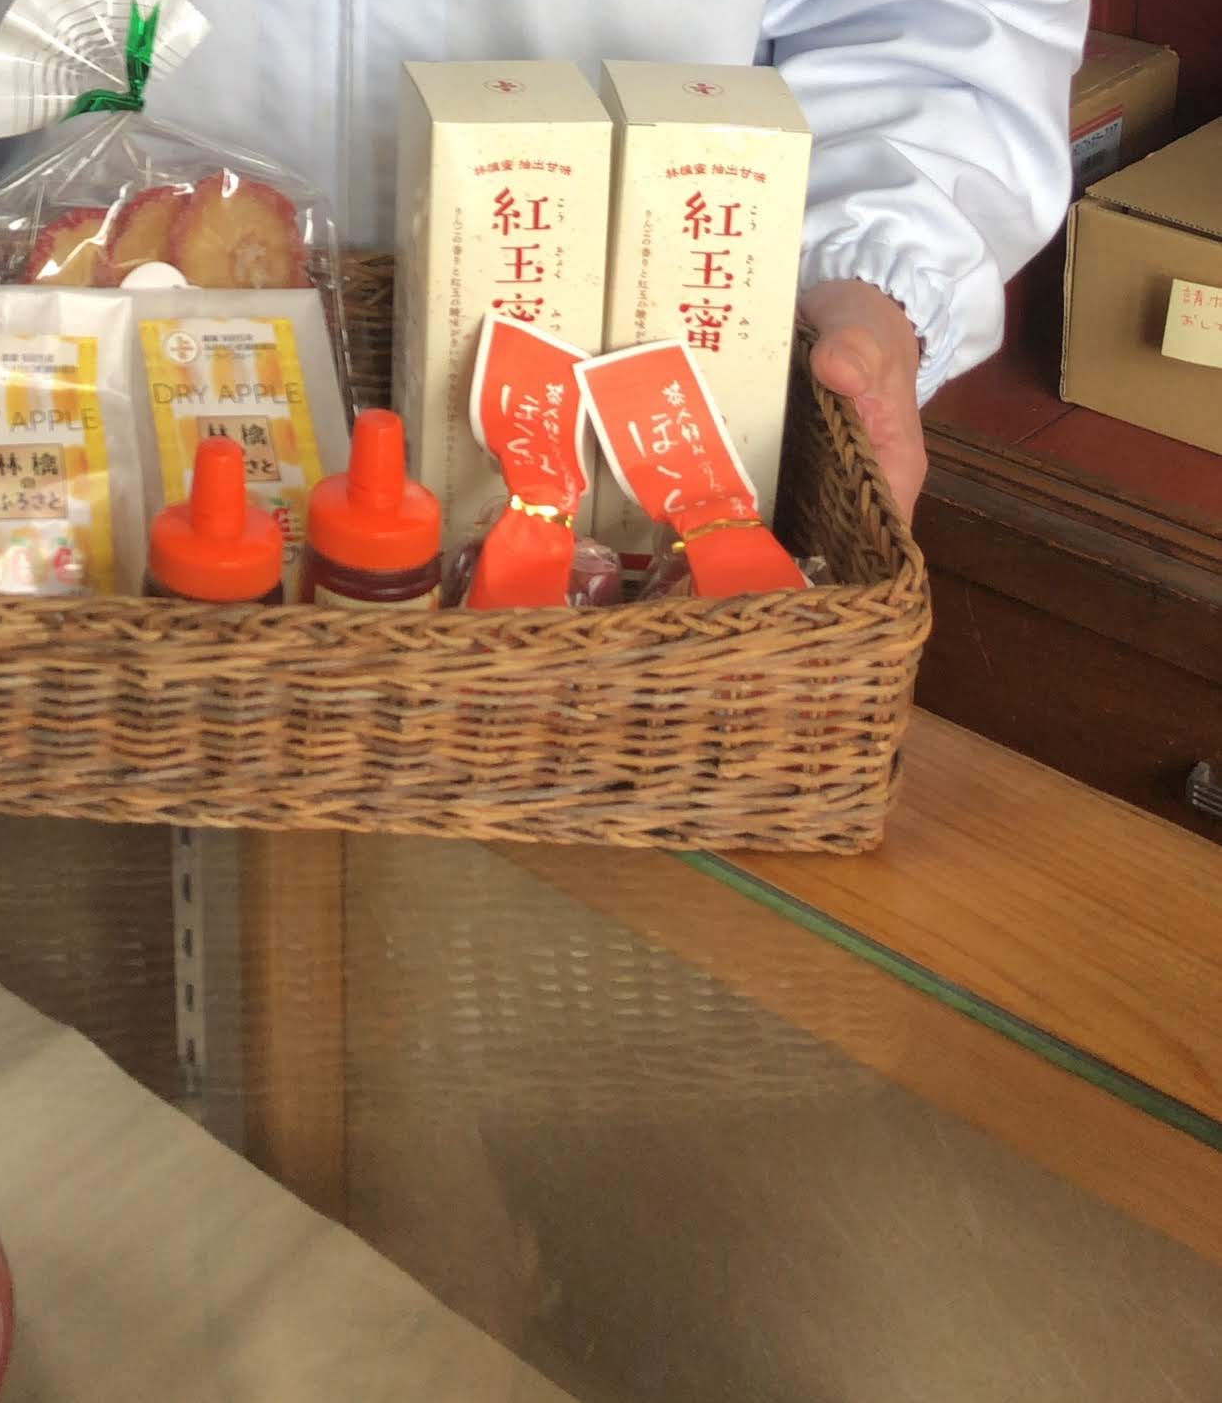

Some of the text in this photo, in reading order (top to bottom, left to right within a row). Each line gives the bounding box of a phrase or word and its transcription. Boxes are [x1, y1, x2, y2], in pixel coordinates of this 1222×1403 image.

[679, 189, 744, 353] 紅玉蜜
[151, 381, 303, 405] DRY APPLE
[8, 406, 99, 433] APPLE
